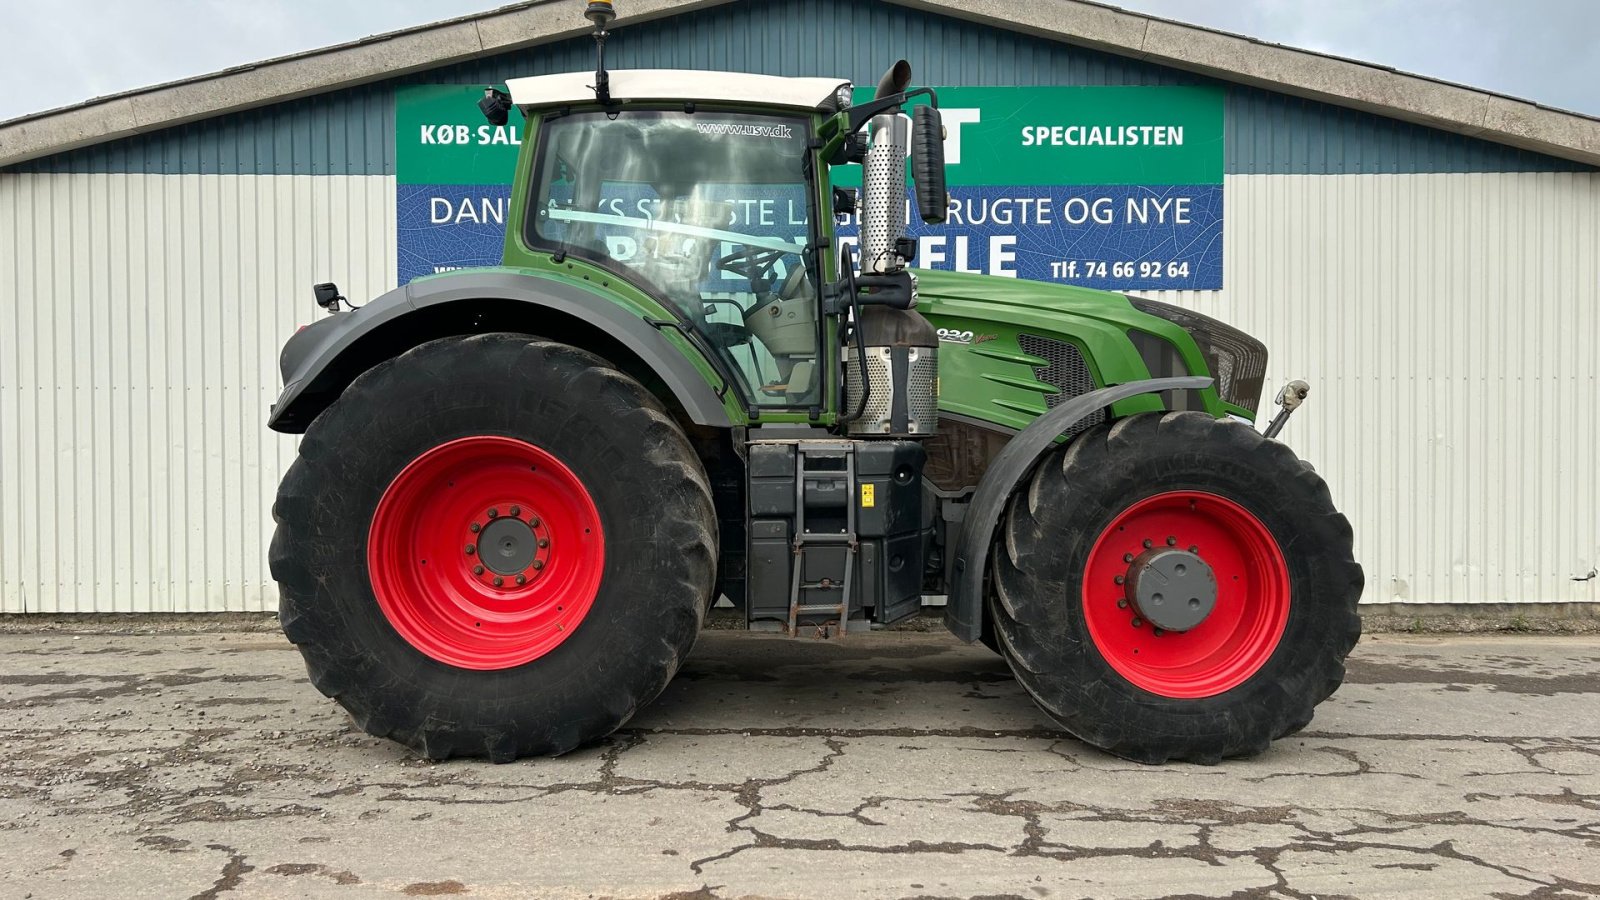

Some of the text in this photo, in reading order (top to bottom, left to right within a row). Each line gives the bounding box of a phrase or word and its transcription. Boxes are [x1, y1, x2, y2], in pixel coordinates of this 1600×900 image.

[697, 123, 792, 138] www.usv.dk
[1022, 127, 1183, 145] SPECIALISTEN
[945, 199, 1051, 225] RUGTE
[1065, 199, 1113, 224] OG
[1128, 199, 1191, 224] NYE
[1051, 262, 1189, 279] Tlf. 74 66 92 64
